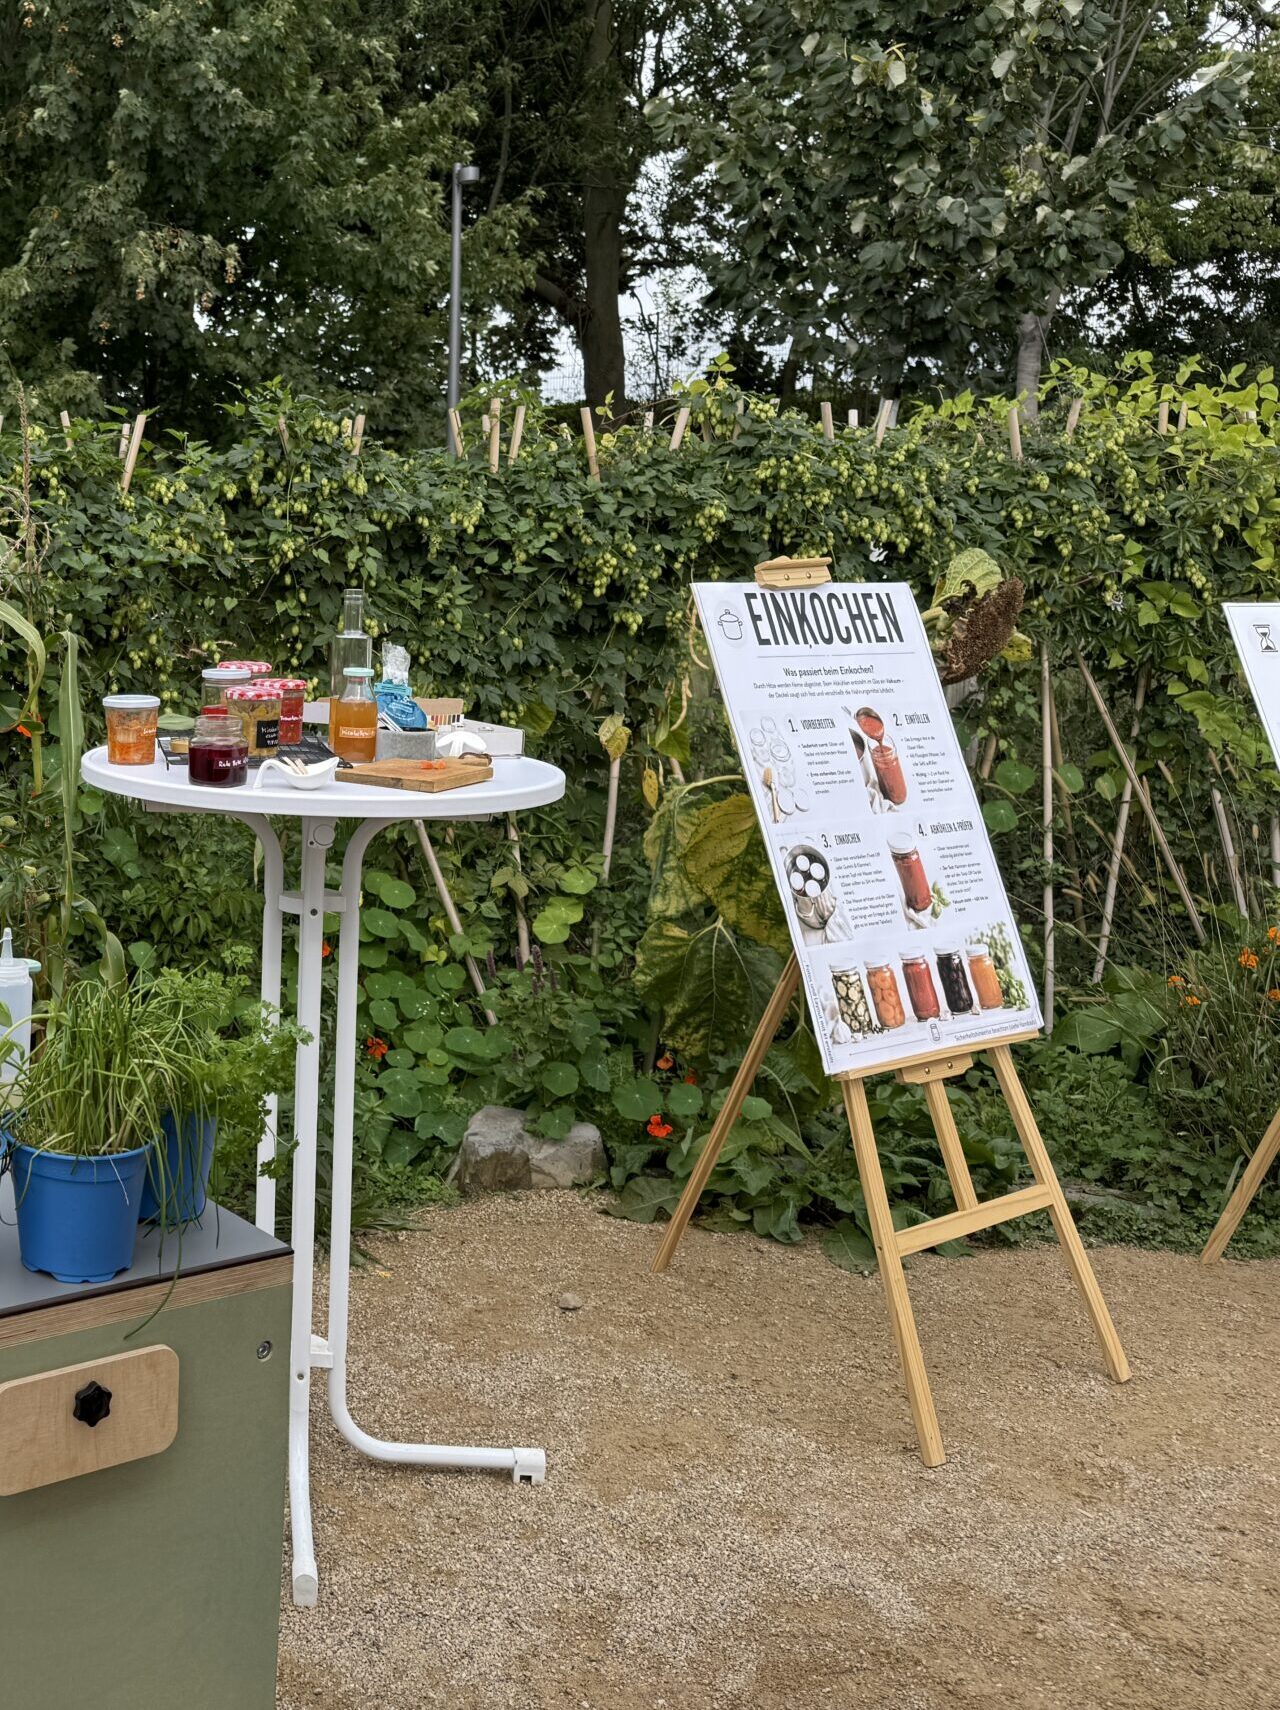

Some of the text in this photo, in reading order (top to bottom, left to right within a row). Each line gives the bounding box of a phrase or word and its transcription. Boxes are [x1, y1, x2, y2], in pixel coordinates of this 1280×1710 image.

[744, 592, 904, 646] EINKOCHEN
[783, 665, 873, 678] Was passiert beim Einkochen?
[788, 718, 836, 732] 1. VORBEREITEN
[893, 712, 930, 726] 2. EINFÜLLEN
[919, 823, 927, 837] 4.
[930, 822, 953, 835] ABKÜHLEN
[957, 820, 973, 831] PRÜFEN
[821, 833, 861, 848] 3. EINKOCHEN
